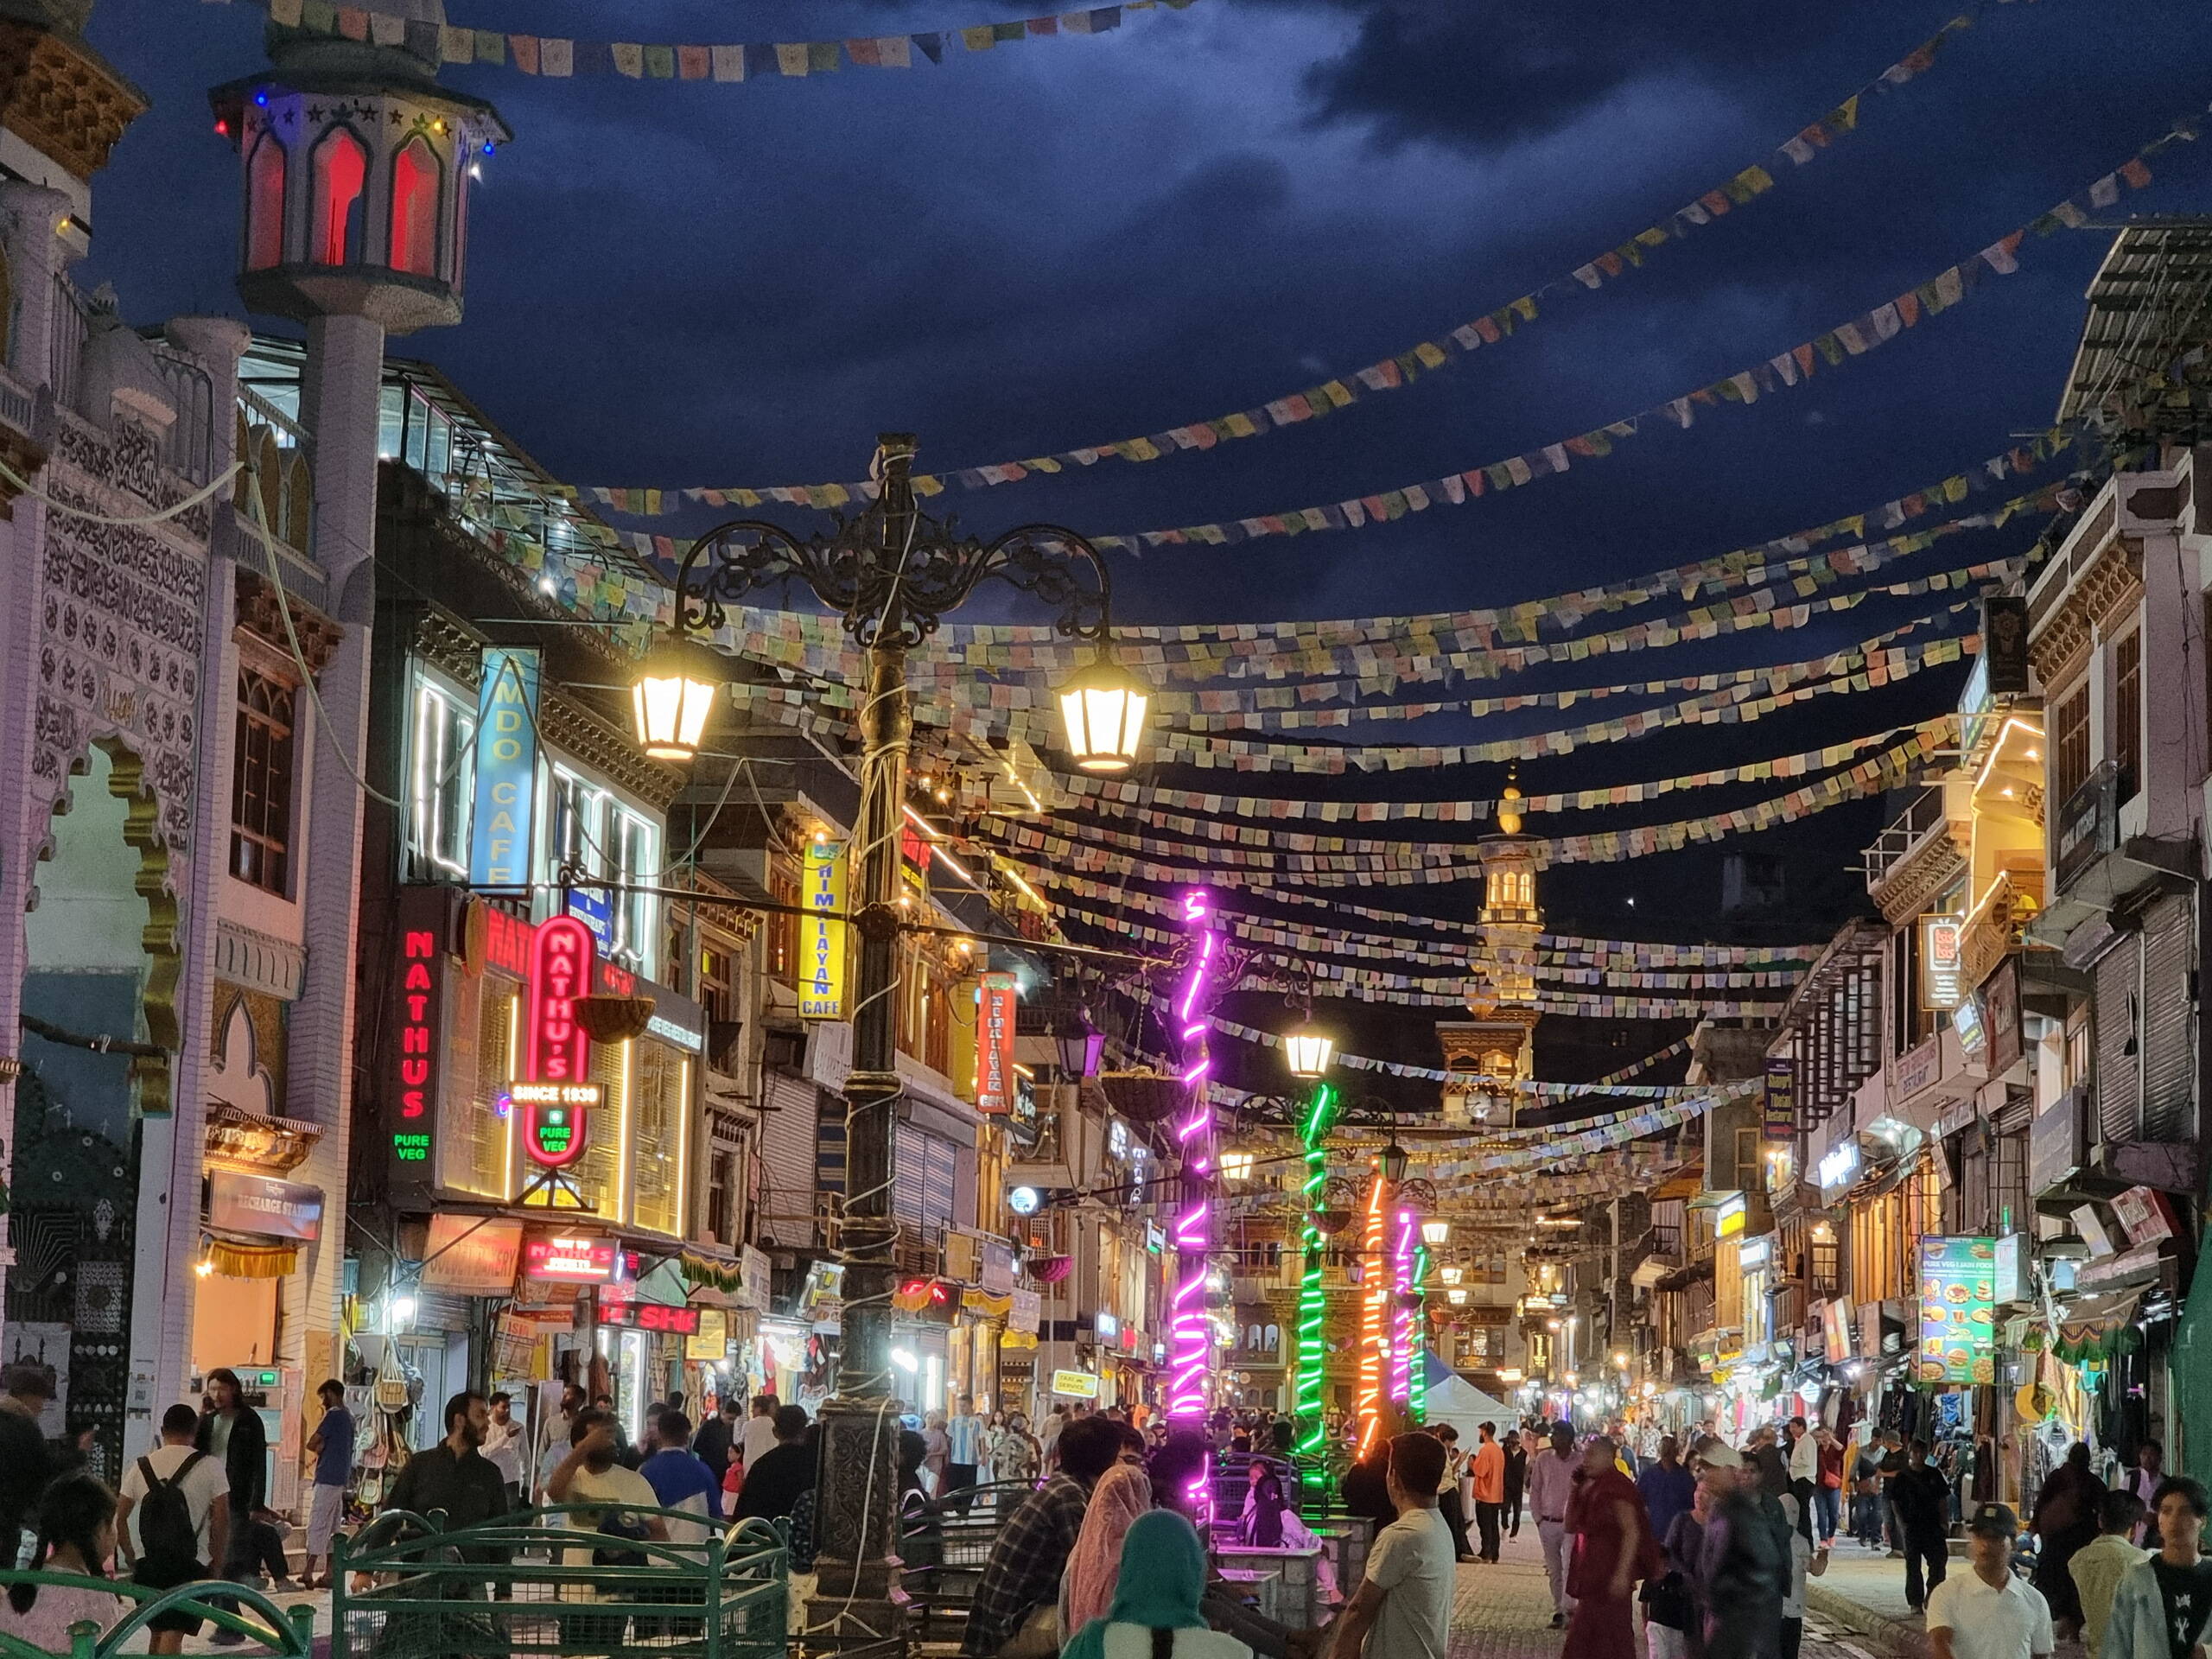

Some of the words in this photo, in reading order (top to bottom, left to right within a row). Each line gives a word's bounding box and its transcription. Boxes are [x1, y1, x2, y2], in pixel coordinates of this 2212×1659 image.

[492, 655, 525, 762] AMDO
[488, 782, 518, 886] CAFE
[545, 933, 575, 1078] NATHU'S
[802, 1001, 839, 1014] CAFE
[402, 932, 434, 1117] NATHUS
[513, 1086, 559, 1101] SINCE
[394, 1135, 429, 1147] PURE
[539, 1128, 570, 1139] PURE
[397, 1147, 426, 1160] VEG
[543, 1141, 567, 1152] VEG
[238, 1194, 282, 1213] RECHARGE
